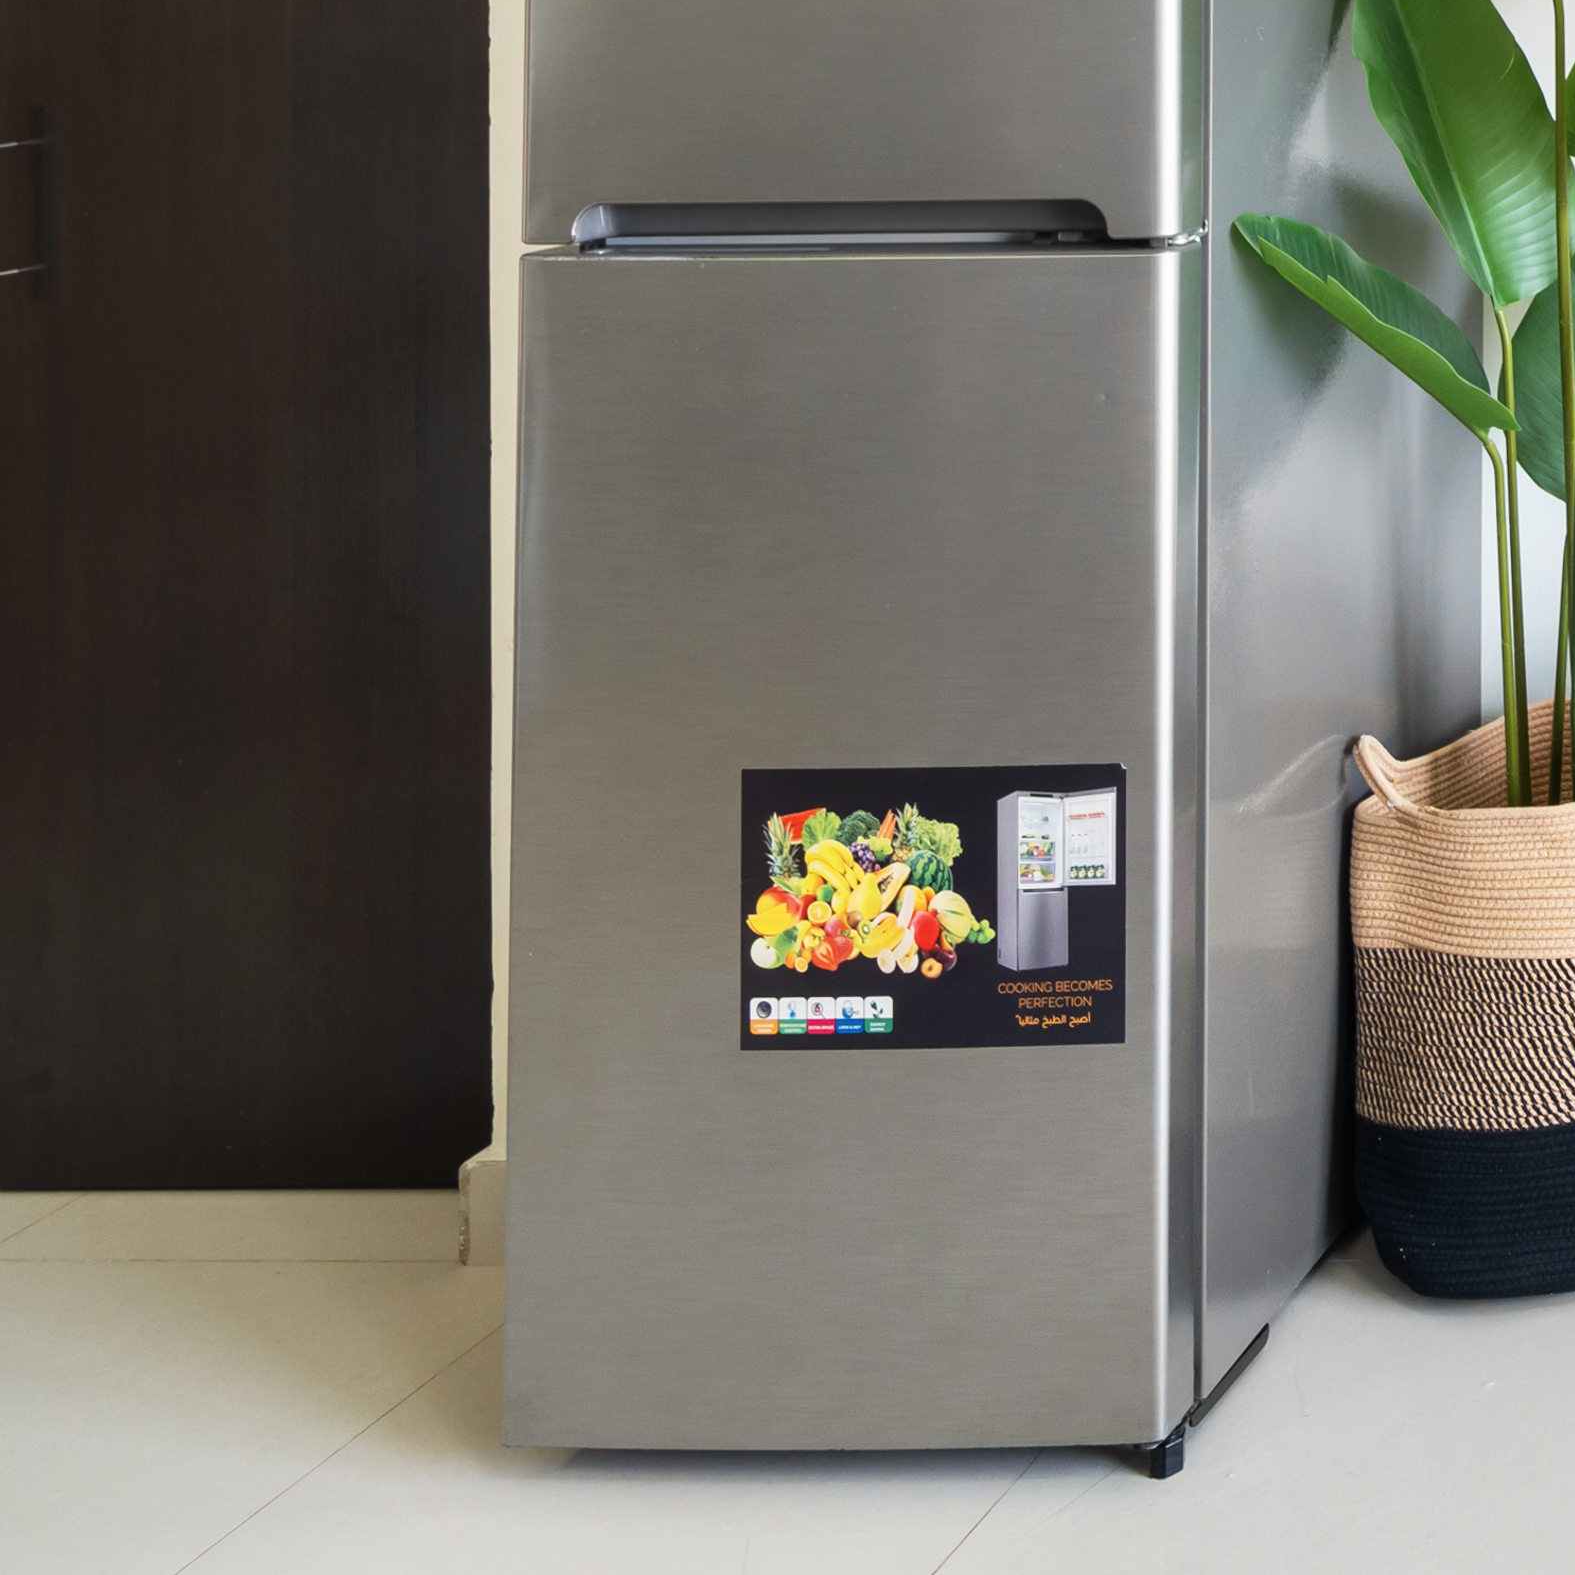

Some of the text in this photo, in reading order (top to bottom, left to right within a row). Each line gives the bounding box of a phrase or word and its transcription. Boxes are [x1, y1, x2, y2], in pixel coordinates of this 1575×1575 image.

[998, 979, 1113, 994] COOKING BECOMES
[1018, 996, 1092, 1009] PERFECTION
[1041, 1014, 1067, 1029] الطبخ
